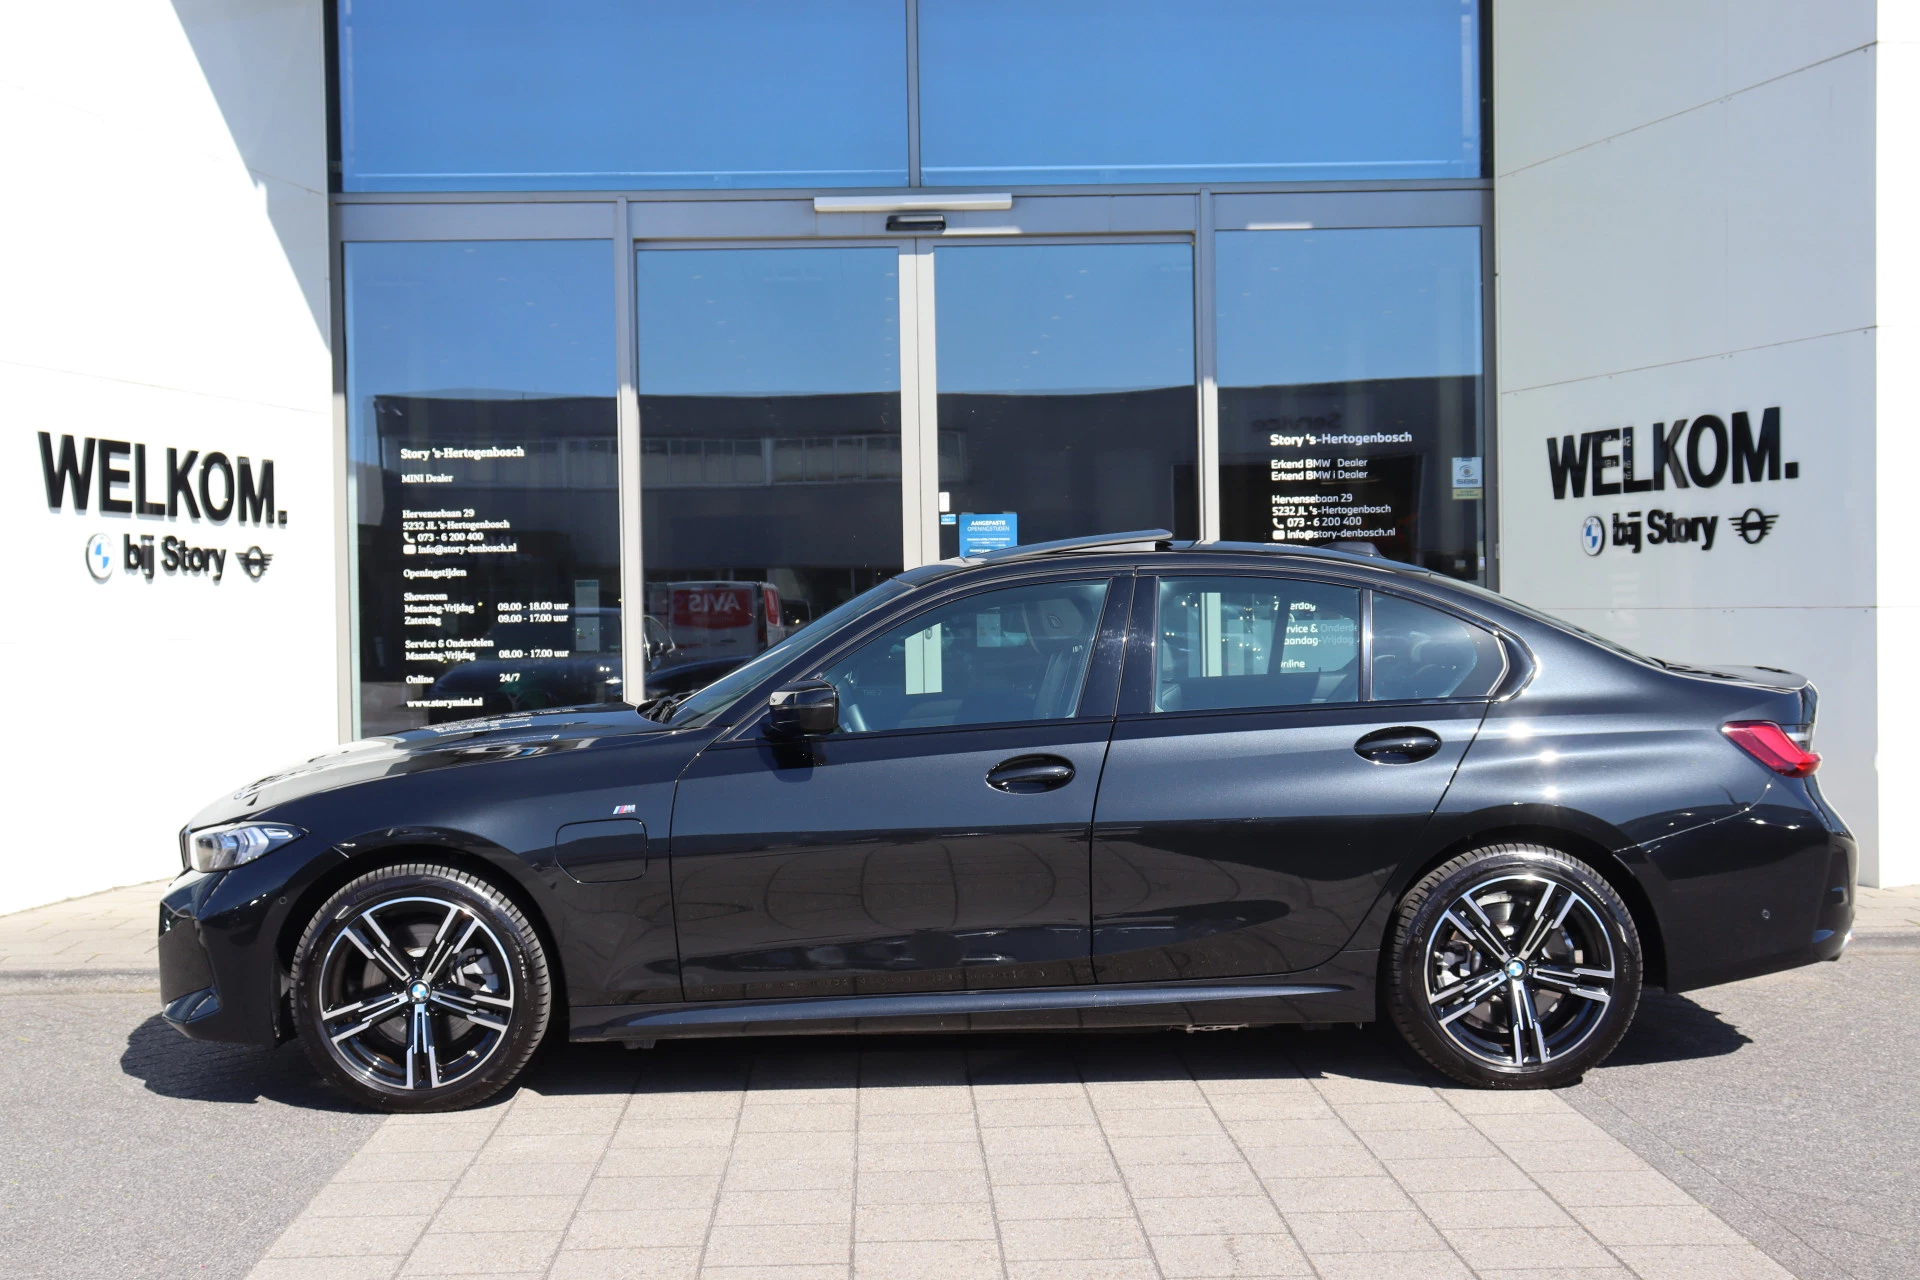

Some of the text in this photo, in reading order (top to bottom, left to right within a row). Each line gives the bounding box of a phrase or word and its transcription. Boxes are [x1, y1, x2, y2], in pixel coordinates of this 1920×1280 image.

[1270, 434, 1304, 447] Story
[401, 448, 430, 461] Story
[1546, 406, 1799, 500] WELKOM.
[1271, 458, 1368, 469] Erkend BMW Dealer
[37, 430, 288, 526] WELKOM.
[401, 473, 453, 483] MINI Dealer
[1271, 470, 1368, 481] Erkend BMW i Dealer
[1272, 494, 1353, 504] Hervensebaan 29
[402, 508, 475, 519] Hervensebaan 29
[1272, 506, 1295, 516] 5232
[1298, 506, 1308, 516] JL
[403, 520, 424, 530] 5232
[426, 521, 437, 530] JL
[1287, 518, 1305, 528] 073
[1314, 518, 1320, 527] 6
[1322, 517, 1341, 526] 200
[1343, 517, 1362, 526] 400
[418, 532, 434, 542] 073
[441, 532, 447, 541] 6
[449, 532, 465, 541] 200
[467, 532, 484, 541] 400
[1287, 528, 1396, 541] info@story-denbosch.nl
[1613, 509, 1718, 553] bij Story
[418, 543, 517, 555] info@story-denbosch.nl
[123, 533, 227, 582] bij Story
[403, 567, 467, 579] Openingstijden
[404, 592, 448, 602] Showroom
[404, 603, 474, 614] Maandag-Vrijdag
[498, 602, 523, 612] 09.00
[530, 601, 552, 611] 18.00
[554, 603, 569, 611] uur
[404, 615, 441, 626] Zaterdag
[498, 614, 523, 624] 09.00
[530, 613, 552, 623] 17.00
[553, 614, 568, 623] uur
[1286, 624, 1308, 633] rvice
[1310, 623, 1318, 633] &
[405, 638, 494, 649] Service & Onderdelen
[1284, 634, 1354, 647] aandag-Vrijdag
[406, 650, 475, 662] Maandag-Vrijdag
[499, 649, 524, 659] 08.00
[530, 648, 552, 659] 17.00
[554, 650, 569, 658] uur
[1281, 659, 1305, 668] nline
[406, 672, 520, 685] Online 24/7
[407, 697, 483, 709] www.storymini.nl
